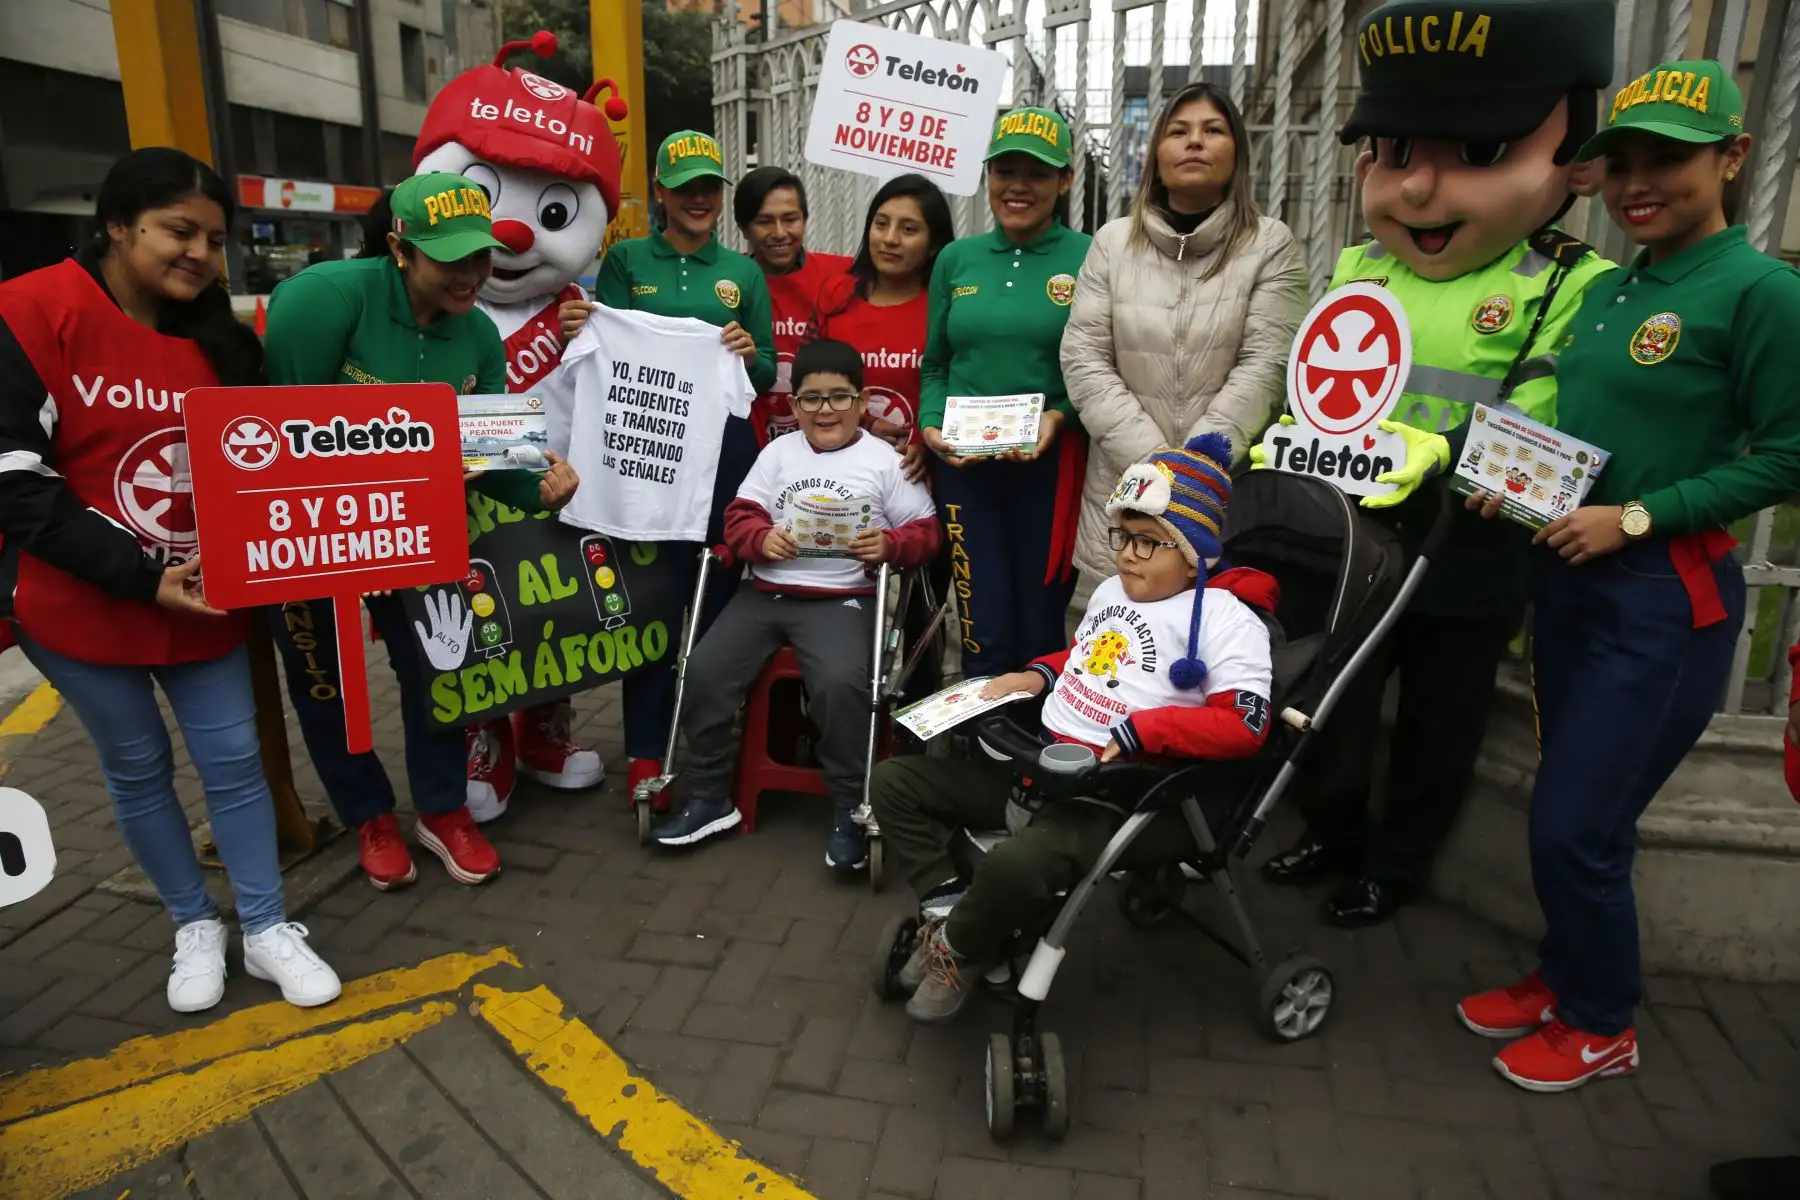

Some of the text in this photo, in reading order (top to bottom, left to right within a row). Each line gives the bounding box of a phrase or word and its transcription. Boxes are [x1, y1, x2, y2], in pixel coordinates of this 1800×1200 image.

[1359, 11, 1491, 66] POLICIA
[1609, 70, 1711, 125] POLICIA
[470, 97, 594, 156] teletoni
[855, 102, 948, 140] 8 Y 9 DE
[996, 112, 1059, 147] POLICIA
[834, 124, 957, 169] NOVIEMBRE
[772, 317, 807, 336] nta
[504, 321, 562, 394] toni
[612, 361, 694, 395] YO, EVITO LOS
[607, 384, 690, 417] ACCIDENTES
[469, 428, 514, 436] PEATONAL
[605, 409, 686, 440] DE TRÁNSITO
[603, 430, 683, 463] RESPETANDO
[602, 454, 676, 485] LAS SEÑALES
[824, 479, 837, 489] DE
[268, 491, 406, 532] 8 Y 9 DE
[246, 525, 431, 572] NOVIEMBRE
[518, 553, 579, 606] AL
[945, 503, 981, 654] TRANSITO
[434, 631, 460, 654] ALTO
[1080, 605, 1157, 673] CAMBIEMOS DE ACTITUD
[430, 619, 669, 723] SEMÁFORO
[1083, 704, 1112, 726] USTED!
